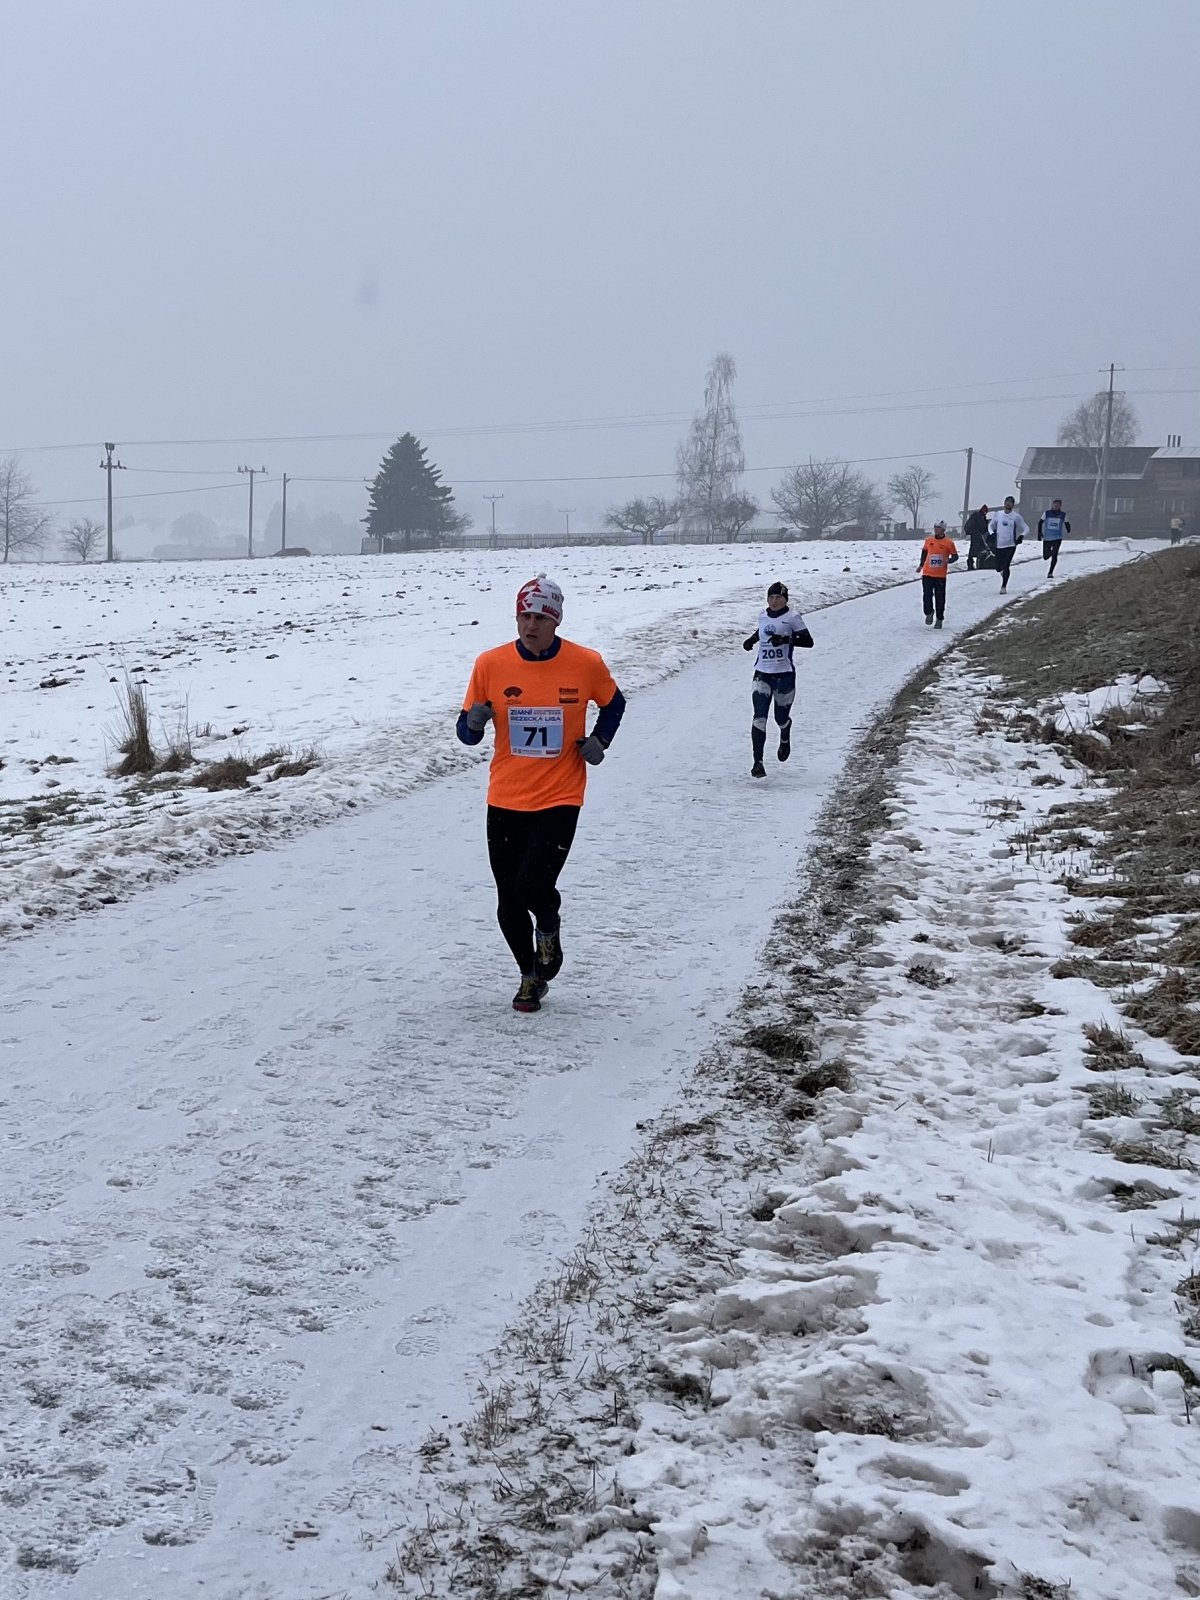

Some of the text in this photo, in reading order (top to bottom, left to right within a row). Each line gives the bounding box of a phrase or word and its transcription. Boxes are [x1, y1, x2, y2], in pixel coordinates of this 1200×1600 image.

[762, 649, 783, 659] 208
[510, 708, 533, 716] ZIMNÍ
[523, 726, 548, 747] 71
